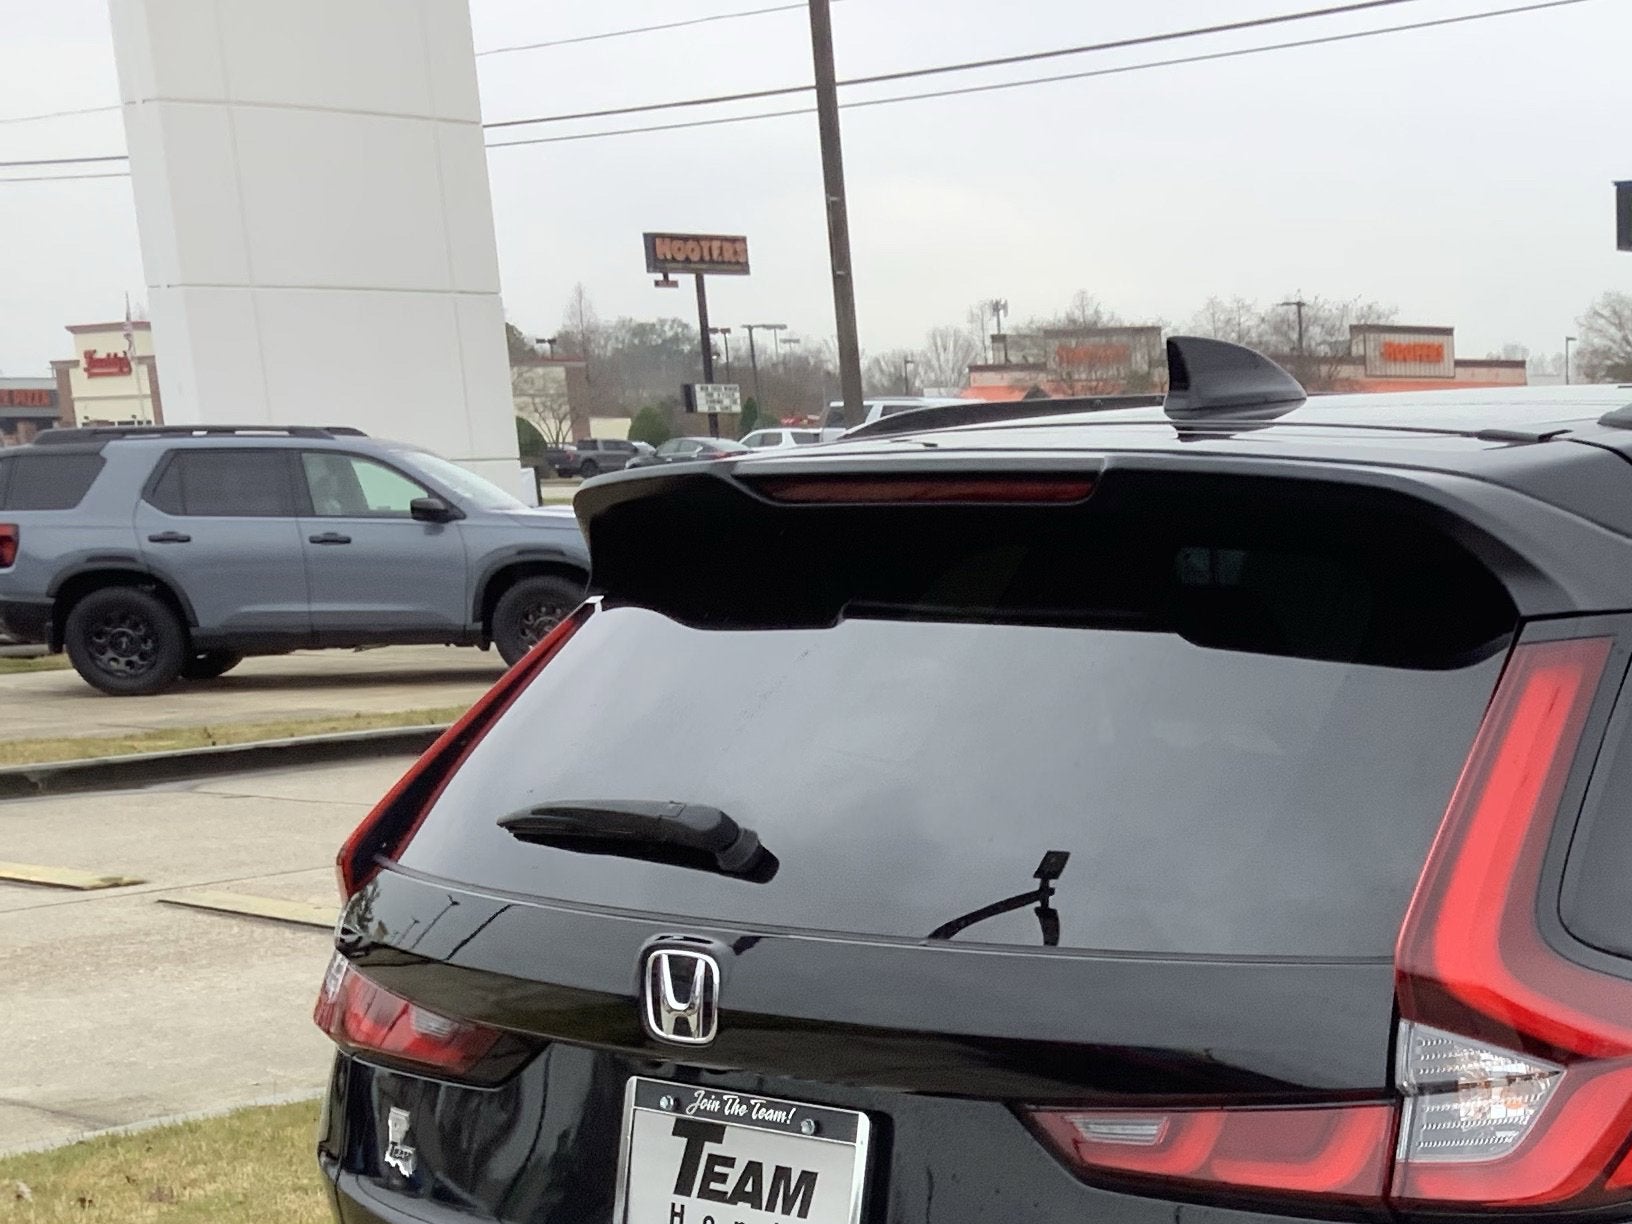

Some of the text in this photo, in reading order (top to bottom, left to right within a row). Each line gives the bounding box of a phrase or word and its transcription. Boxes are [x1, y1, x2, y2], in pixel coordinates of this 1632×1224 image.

[655, 237, 747, 263] HOOTERS
[686, 1089, 796, 1125] Join The Team!
[671, 1117, 819, 1220] TEAM
